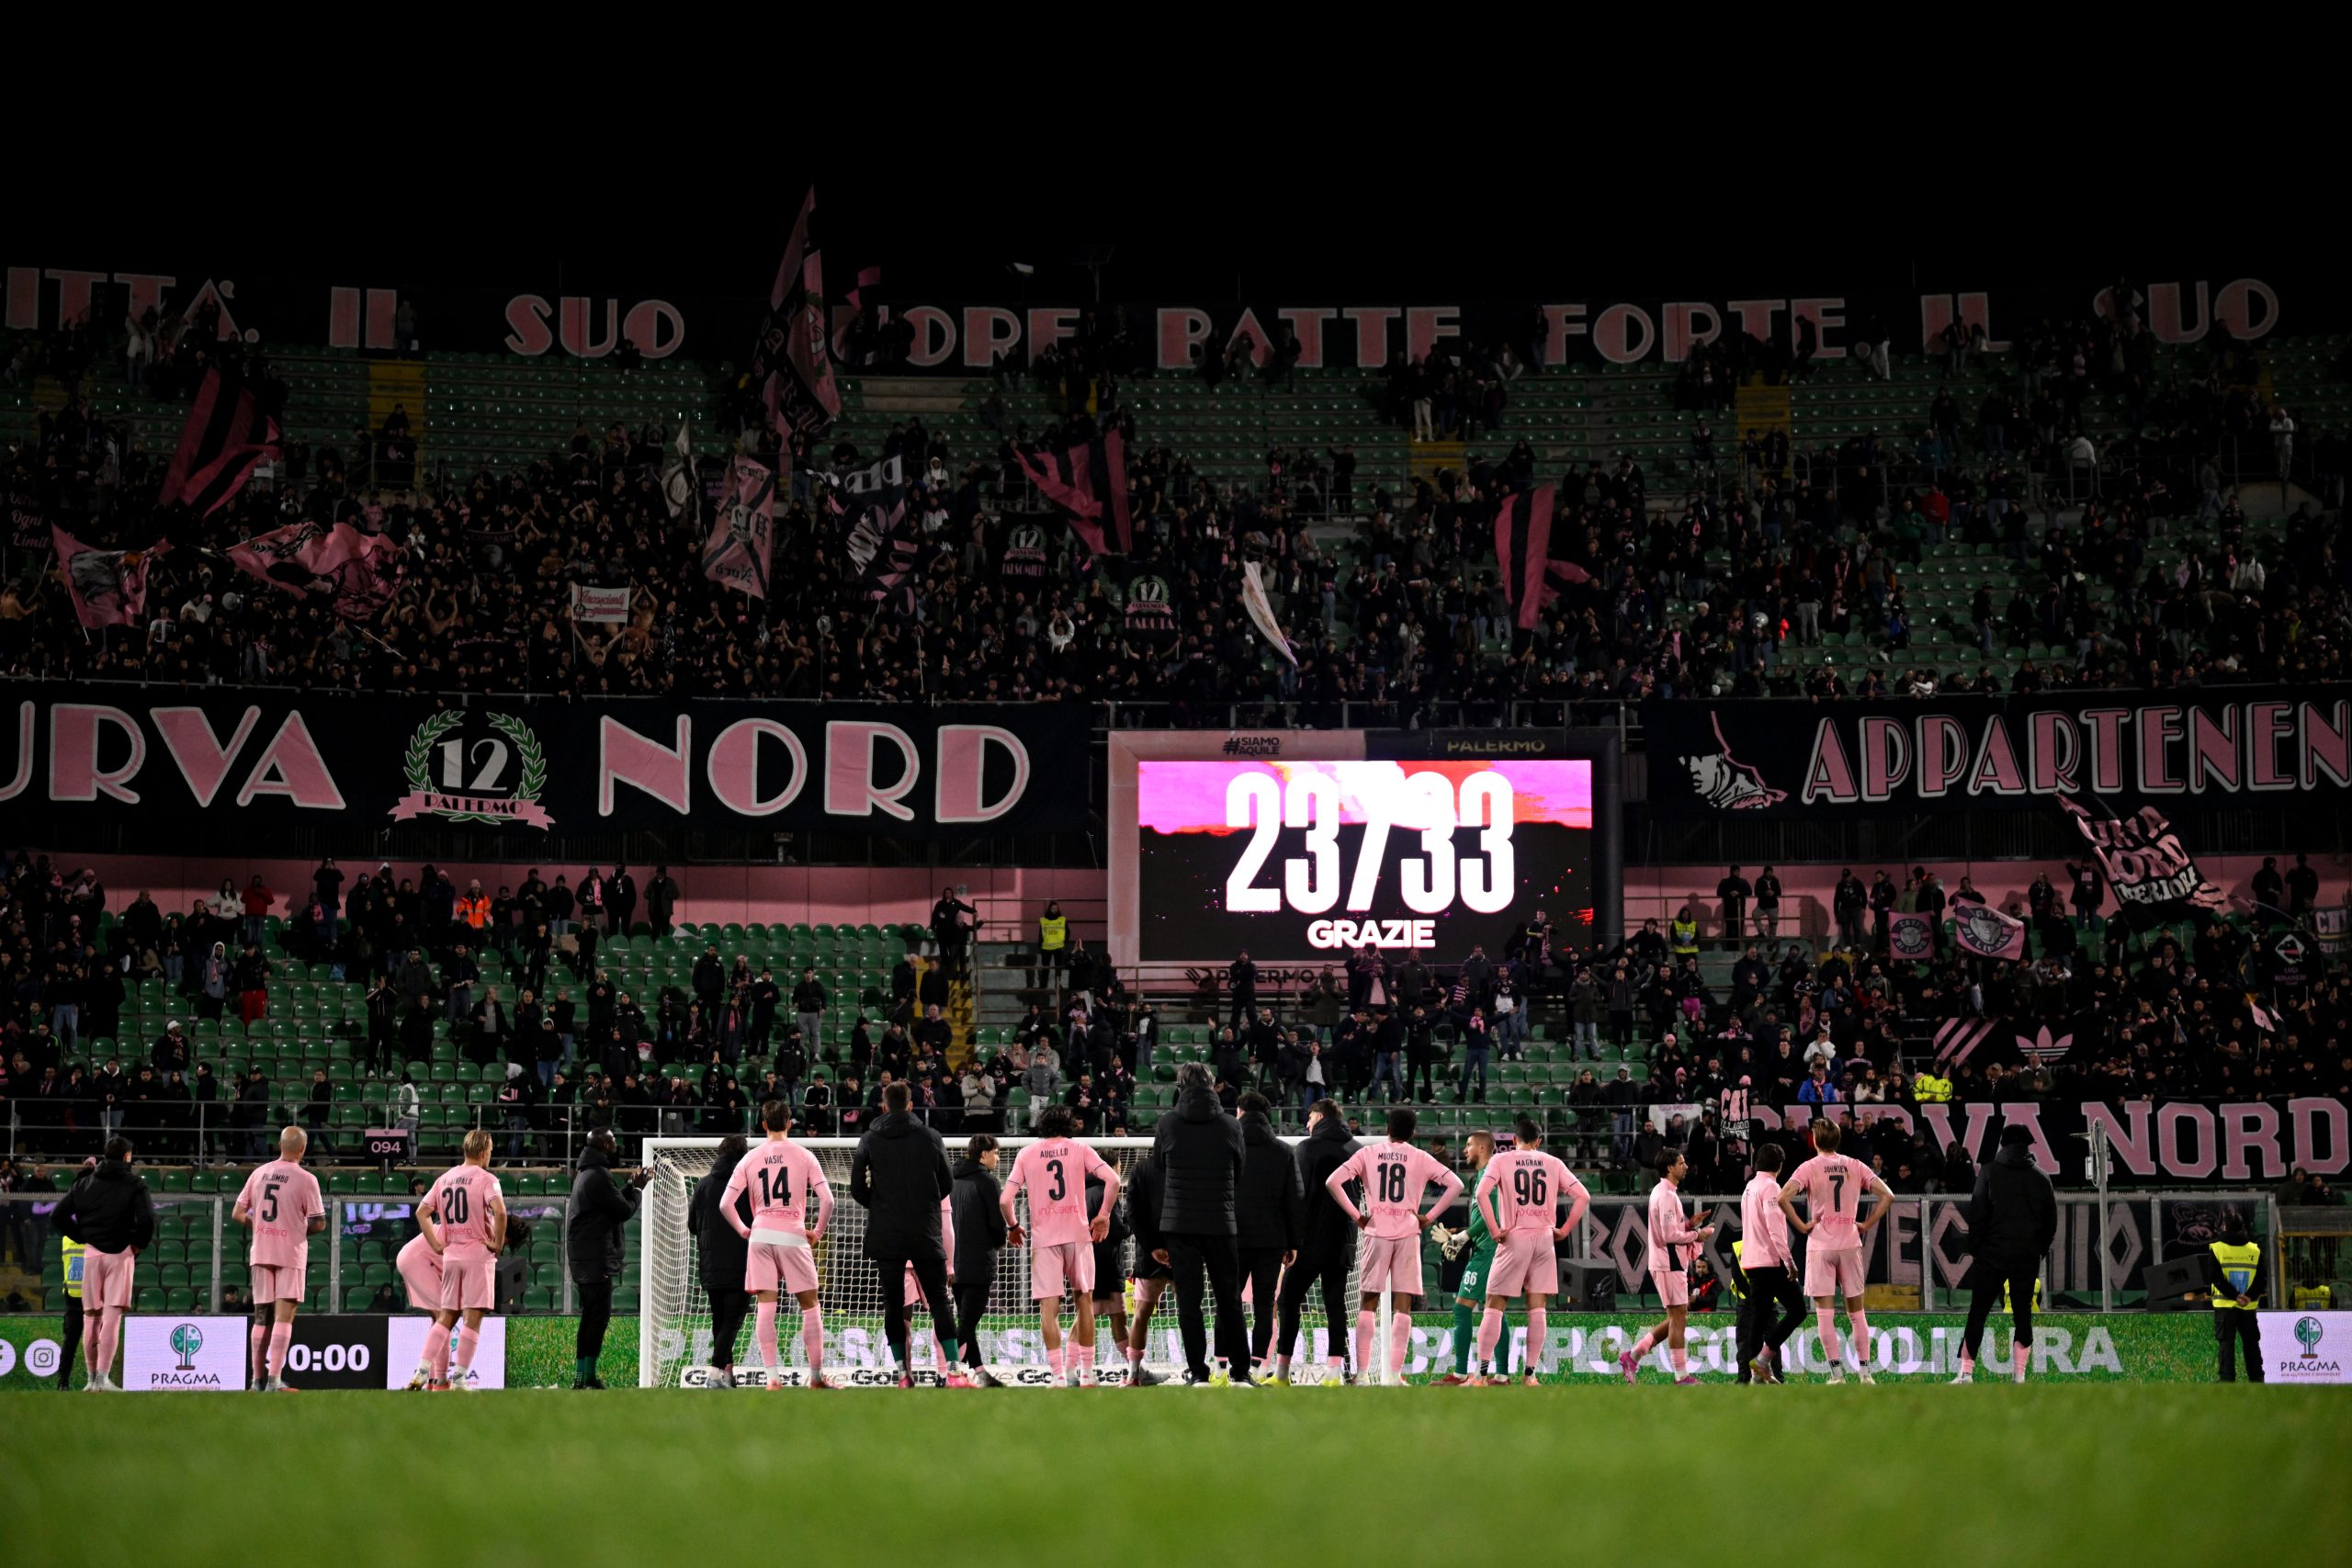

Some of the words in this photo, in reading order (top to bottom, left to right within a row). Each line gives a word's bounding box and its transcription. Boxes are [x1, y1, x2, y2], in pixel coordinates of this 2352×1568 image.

[504, 294, 685, 358] SUO
[1018, 529, 1037, 549] 12
[1139, 581, 1160, 602] 12
[1240, 745, 1281, 756] AQUILE
[1447, 739, 1545, 754] PALERMO
[1802, 700, 2352, 805] APPARTENEN
[437, 739, 508, 791] 12
[598, 713, 1031, 823] NORD
[424, 793, 525, 816] PALERMO
[1226, 771, 1515, 915] 23733
[1306, 919, 1436, 949] GRAZIE
[1216, 969, 1315, 984] PERMO
[371, 1141, 401, 1153] 094
[2081, 1097, 2352, 1180] NORD
[1040, 1148, 1069, 1158] AUGELLO
[1377, 1152, 1408, 1163] MODESTO
[1515, 1159, 1544, 1168] MAGNANI
[758, 1167, 791, 1207] 14
[1046, 1159, 1066, 1201] 3
[1377, 1162, 1407, 1203] 18
[1513, 1168, 1547, 1206] 96
[1828, 1175, 1844, 1213] 7
[262, 1183, 280, 1223] 5
[442, 1186, 469, 1224] 20
[1464, 1270, 1476, 1285] 66
[265, 1344, 370, 1371] 0:00
[2280, 1360, 2341, 1372] PRAGMA
[151, 1372, 220, 1384] PRAGMA
